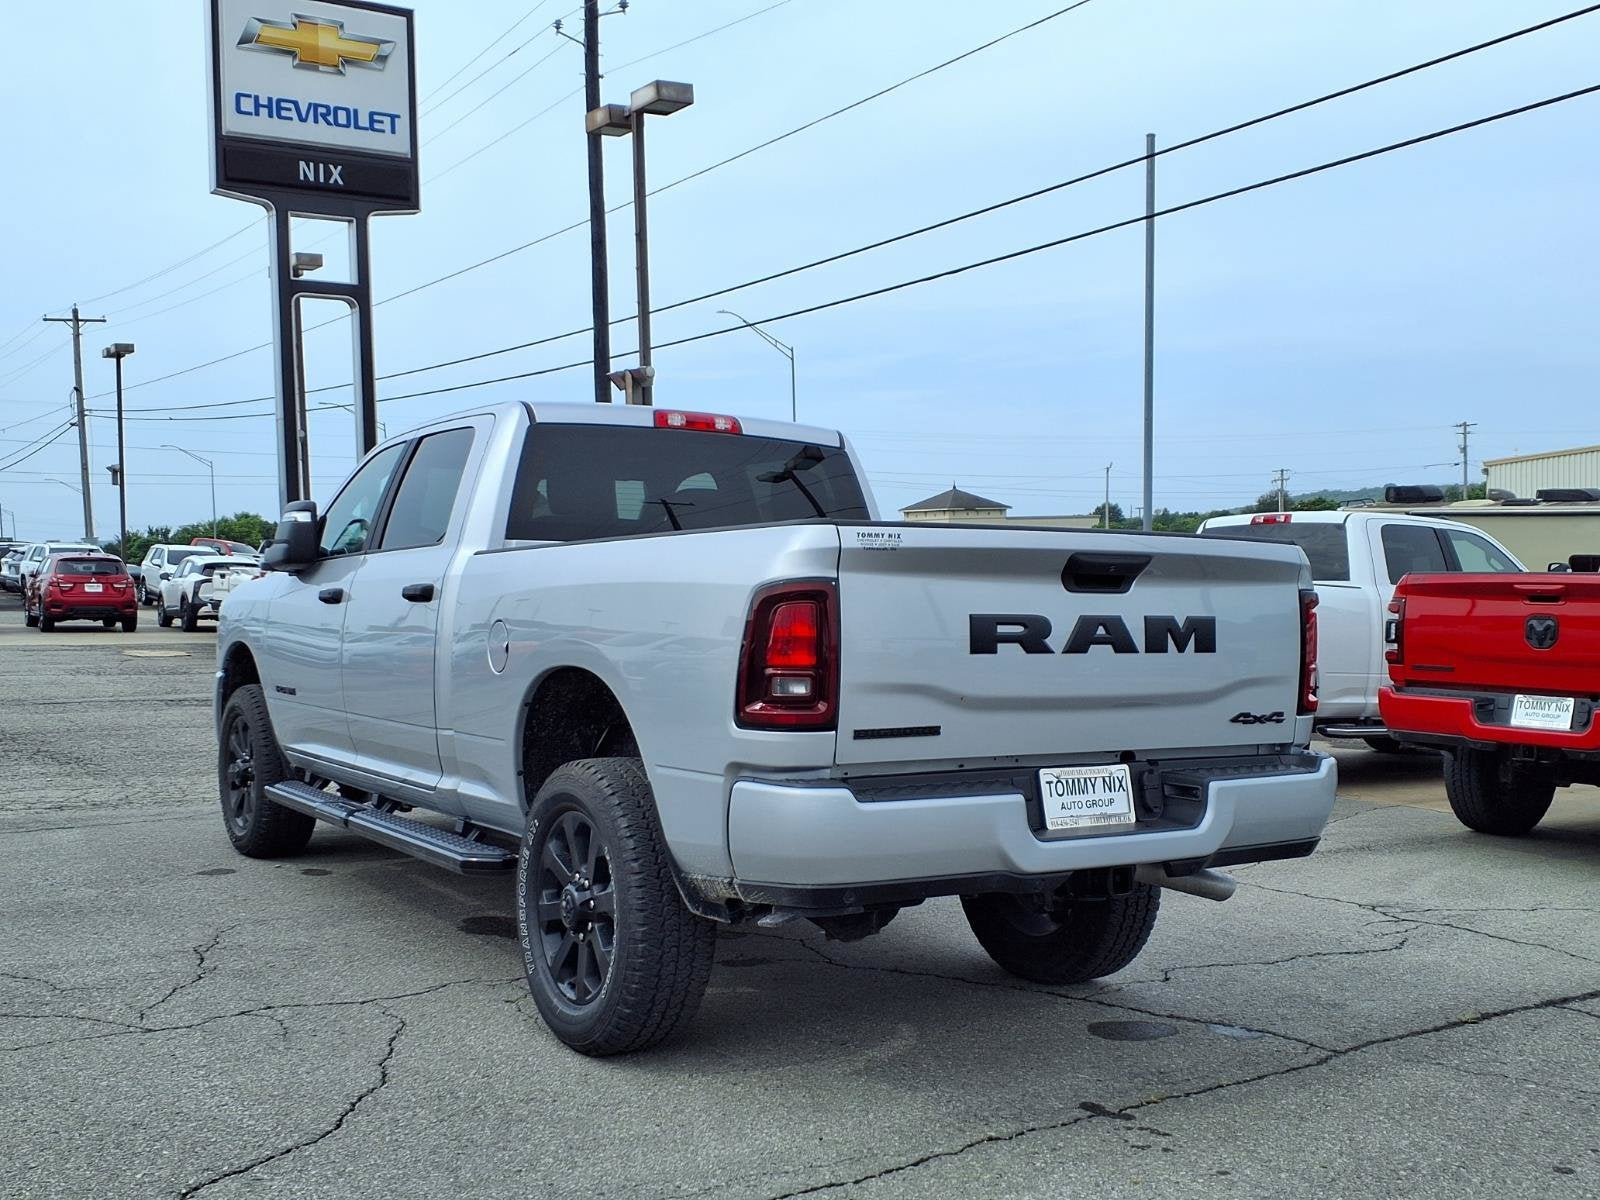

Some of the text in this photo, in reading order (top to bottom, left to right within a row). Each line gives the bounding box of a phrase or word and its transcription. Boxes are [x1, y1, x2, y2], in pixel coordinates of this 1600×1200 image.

[235, 92, 401, 134] CHEVROLET
[298, 160, 345, 185] NIX
[969, 614, 1216, 654] RAM
[1229, 711, 1286, 725] 4x4
[1518, 700, 1571, 713] TOMMY NIX
[1046, 775, 1126, 798] TOMMY NIX
[1060, 798, 1115, 811] AUTO GROUP
[517, 846, 536, 975] TRANSFORCE
